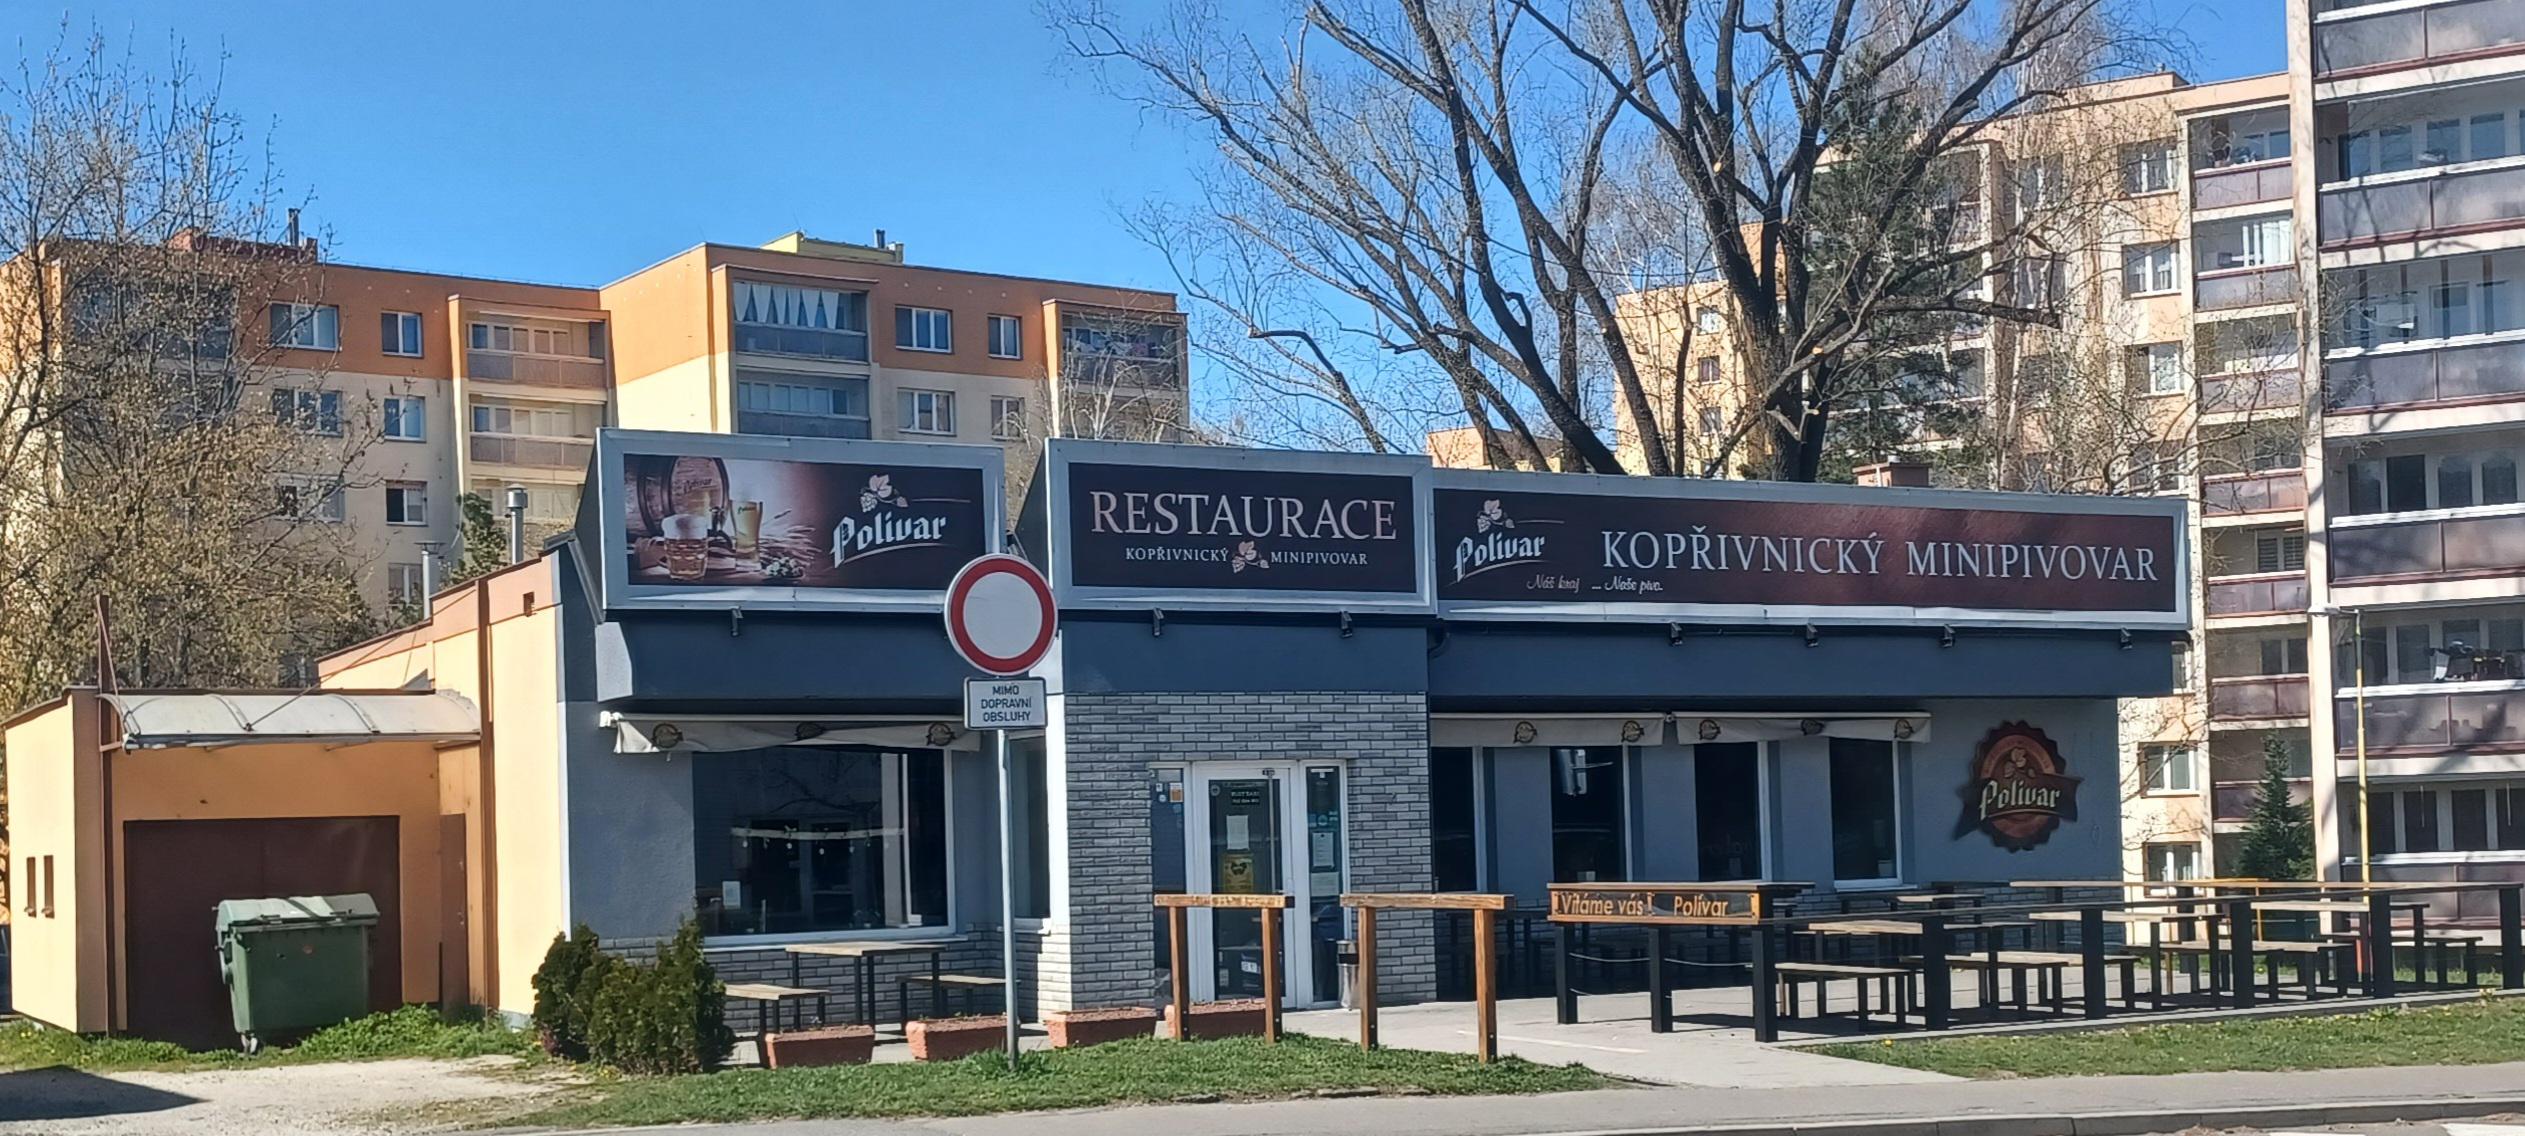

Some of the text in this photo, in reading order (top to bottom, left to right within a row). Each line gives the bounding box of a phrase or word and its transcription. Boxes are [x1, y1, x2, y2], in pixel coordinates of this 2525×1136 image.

[1089, 490, 1397, 541] RESTAURACE
[1125, 545, 1368, 566] KOPŘIVNICKÝ MINIPIVOVAR
[1602, 525, 2159, 582] KOPŘIVNICKÝ MINIPIVOVAR
[992, 685, 1020, 696] MIMO
[981, 697, 1032, 709] DOPRAVNÍ
[983, 711, 1031, 723] OBSLUHY
[1618, 893, 1644, 915] vás
[1674, 893, 1728, 917] Polívar
